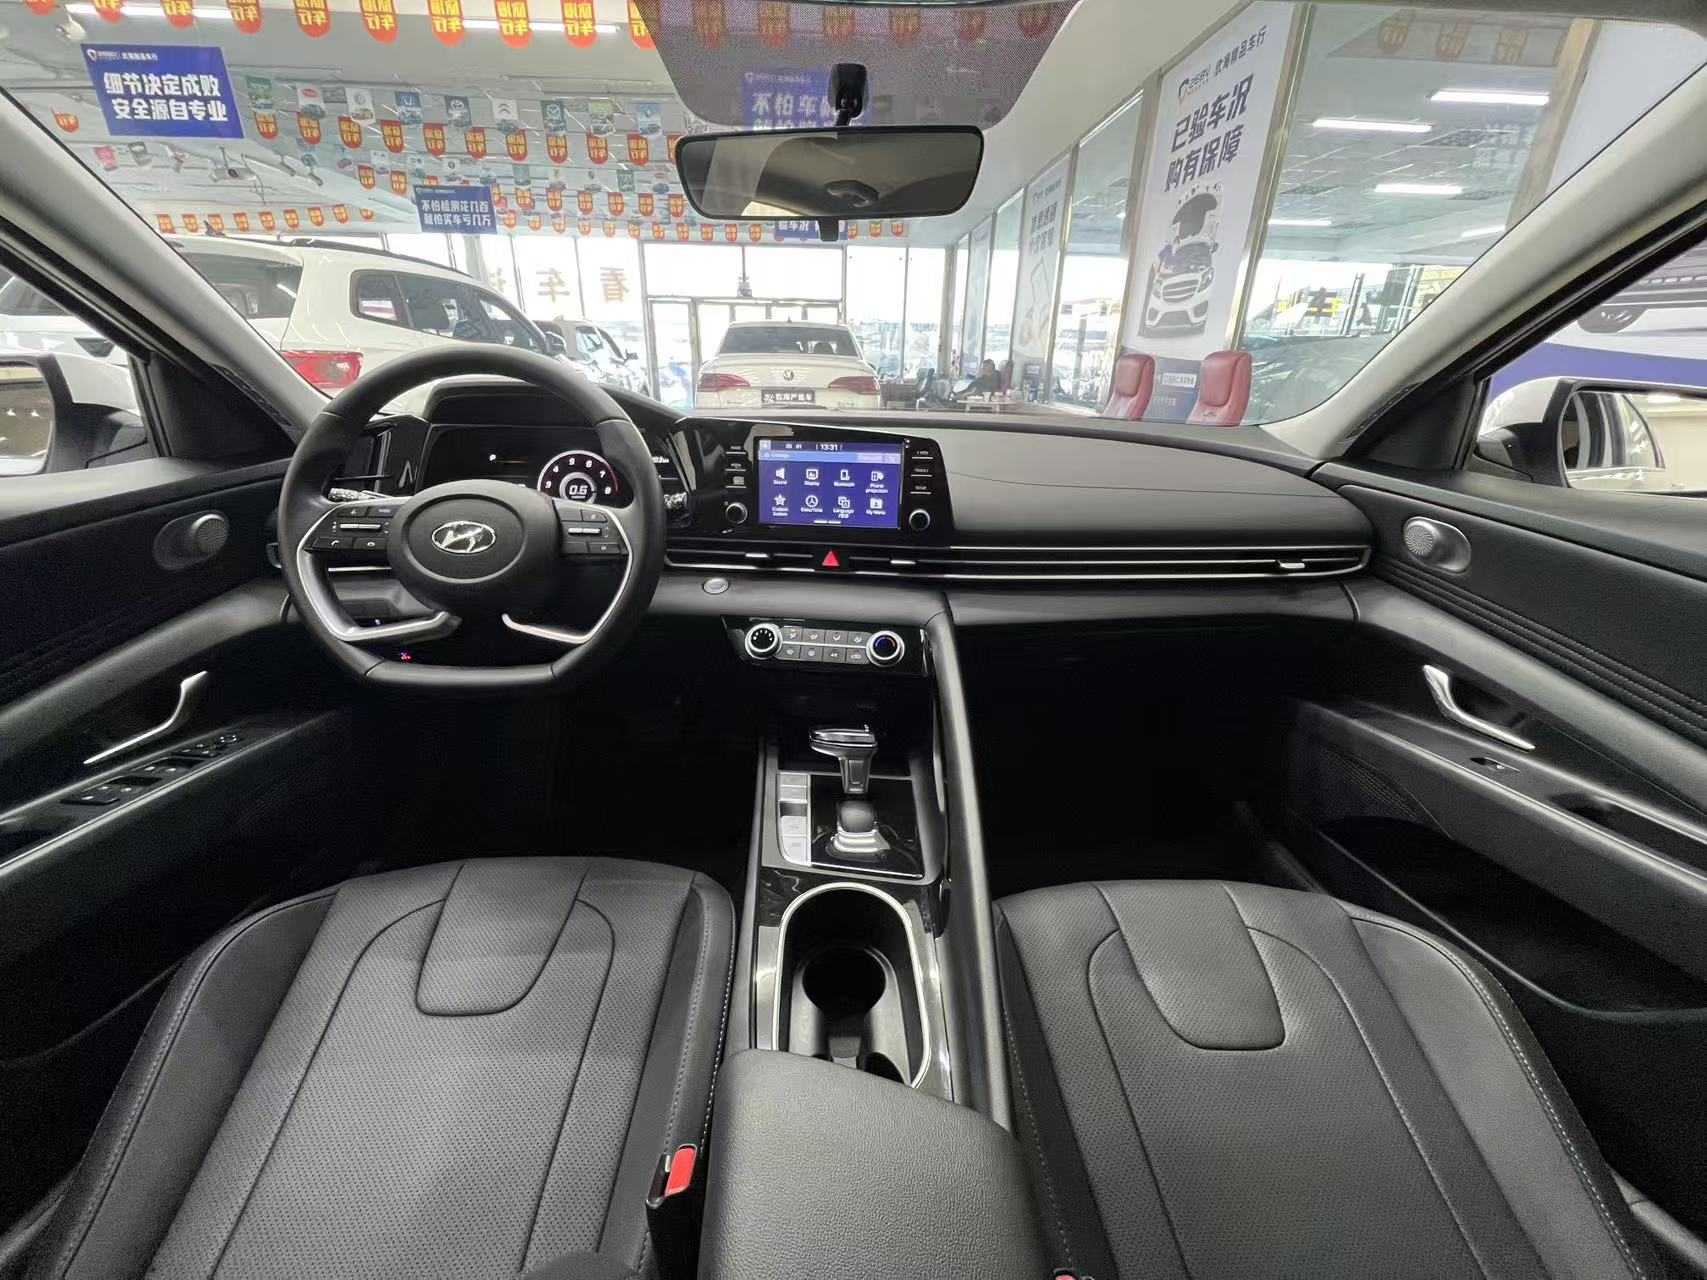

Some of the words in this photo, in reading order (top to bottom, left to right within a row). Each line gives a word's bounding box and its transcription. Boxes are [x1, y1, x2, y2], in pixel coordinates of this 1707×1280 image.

[103, 71, 221, 97] 细节决定成败
[111, 98, 228, 122] 安全源自专业
[1171, 73, 1254, 153] 已验车况
[1164, 124, 1244, 193] 购有保障
